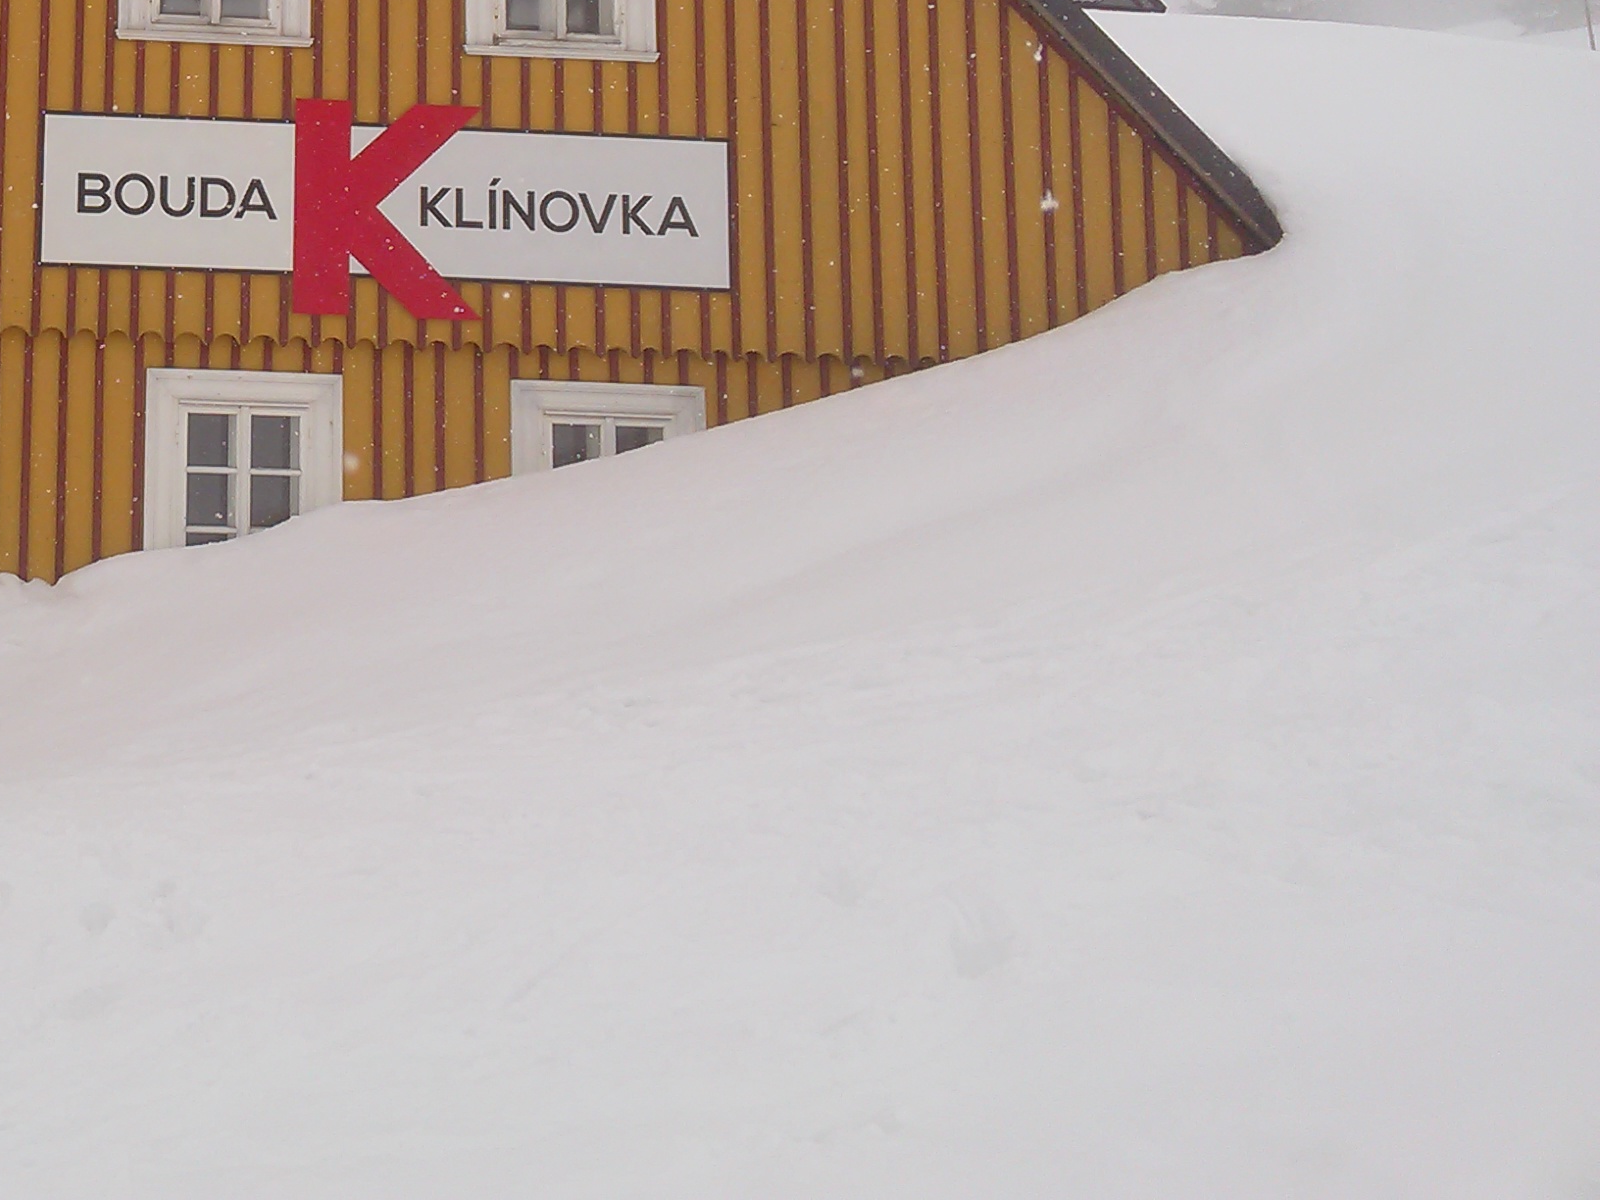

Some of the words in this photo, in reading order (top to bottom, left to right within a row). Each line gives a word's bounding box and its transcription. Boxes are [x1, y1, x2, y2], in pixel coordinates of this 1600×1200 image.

[76, 172, 278, 221] BOUDA
[419, 177, 700, 238] KLÍNOVKA
[290, 96, 485, 322] K
